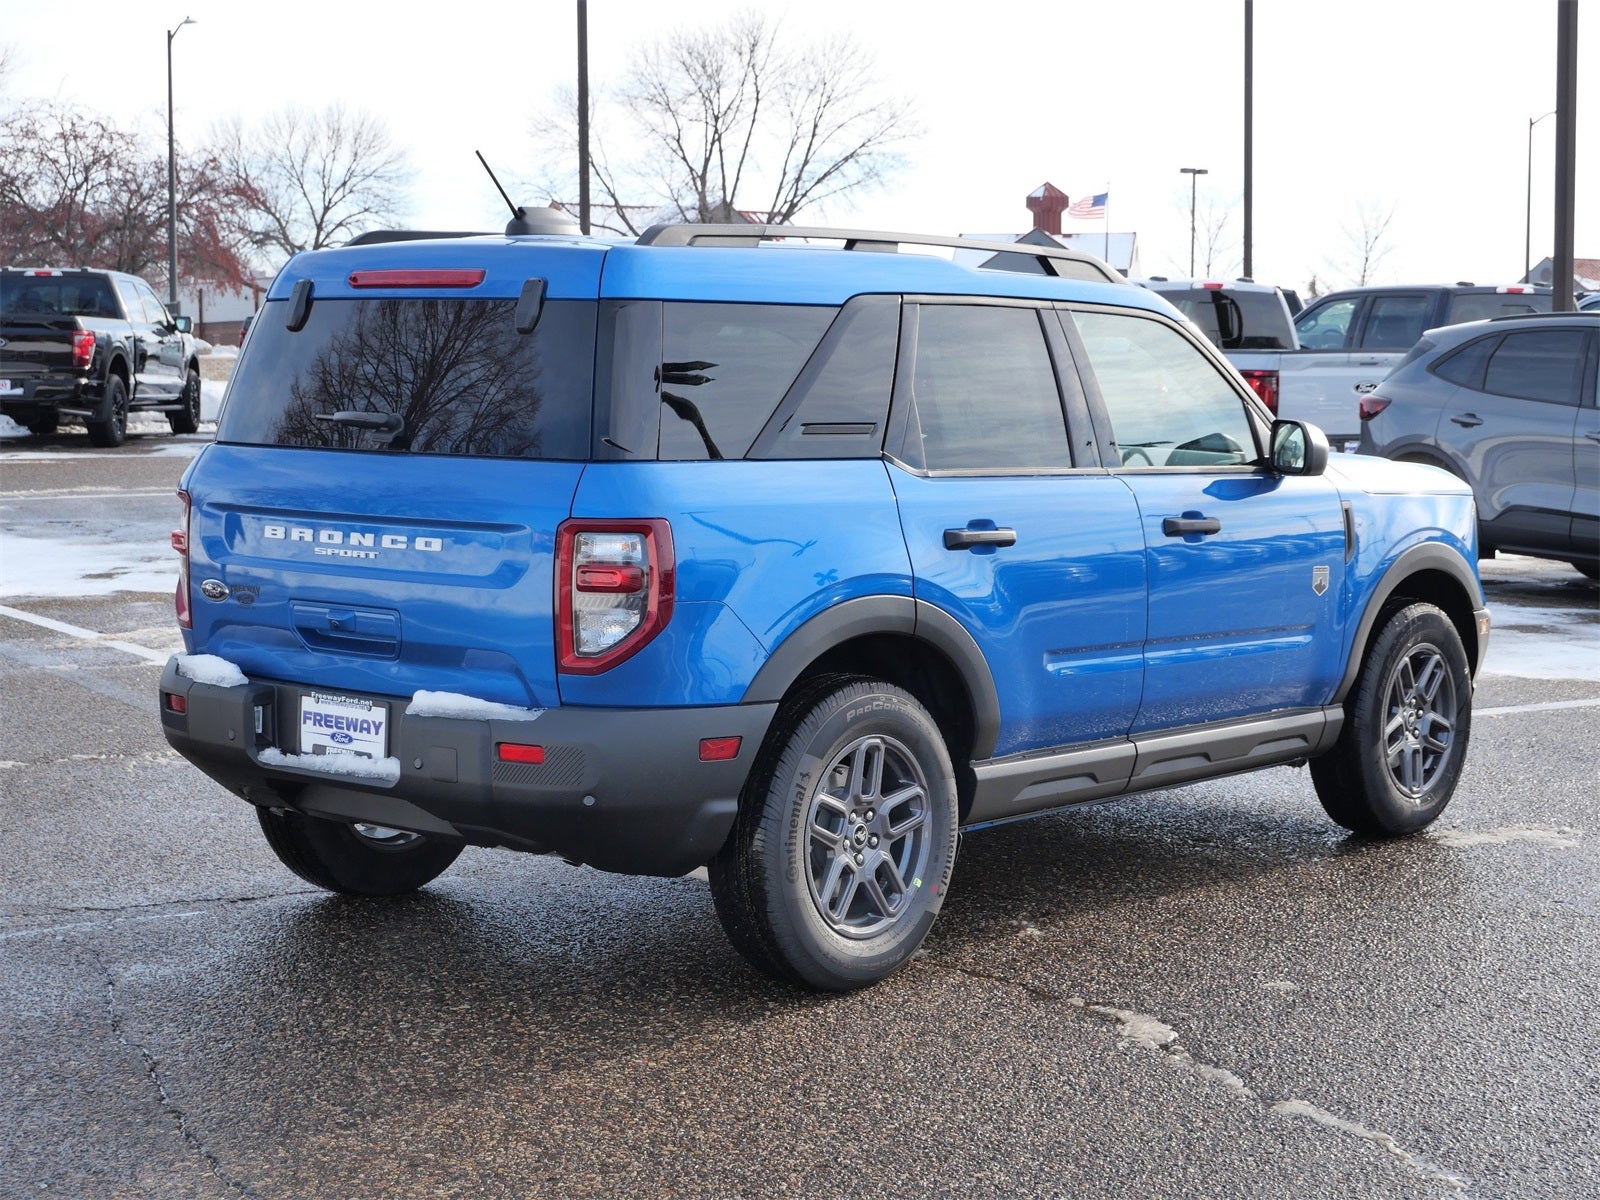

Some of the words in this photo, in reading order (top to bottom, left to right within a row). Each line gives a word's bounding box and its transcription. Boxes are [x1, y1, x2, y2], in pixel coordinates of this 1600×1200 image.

[264, 525, 443, 552] BRONCO
[314, 547, 379, 559] SPORT
[311, 692, 373, 706] FreewayFord.net
[303, 711, 383, 735] FREEWAY
[332, 732, 353, 745] Ford
